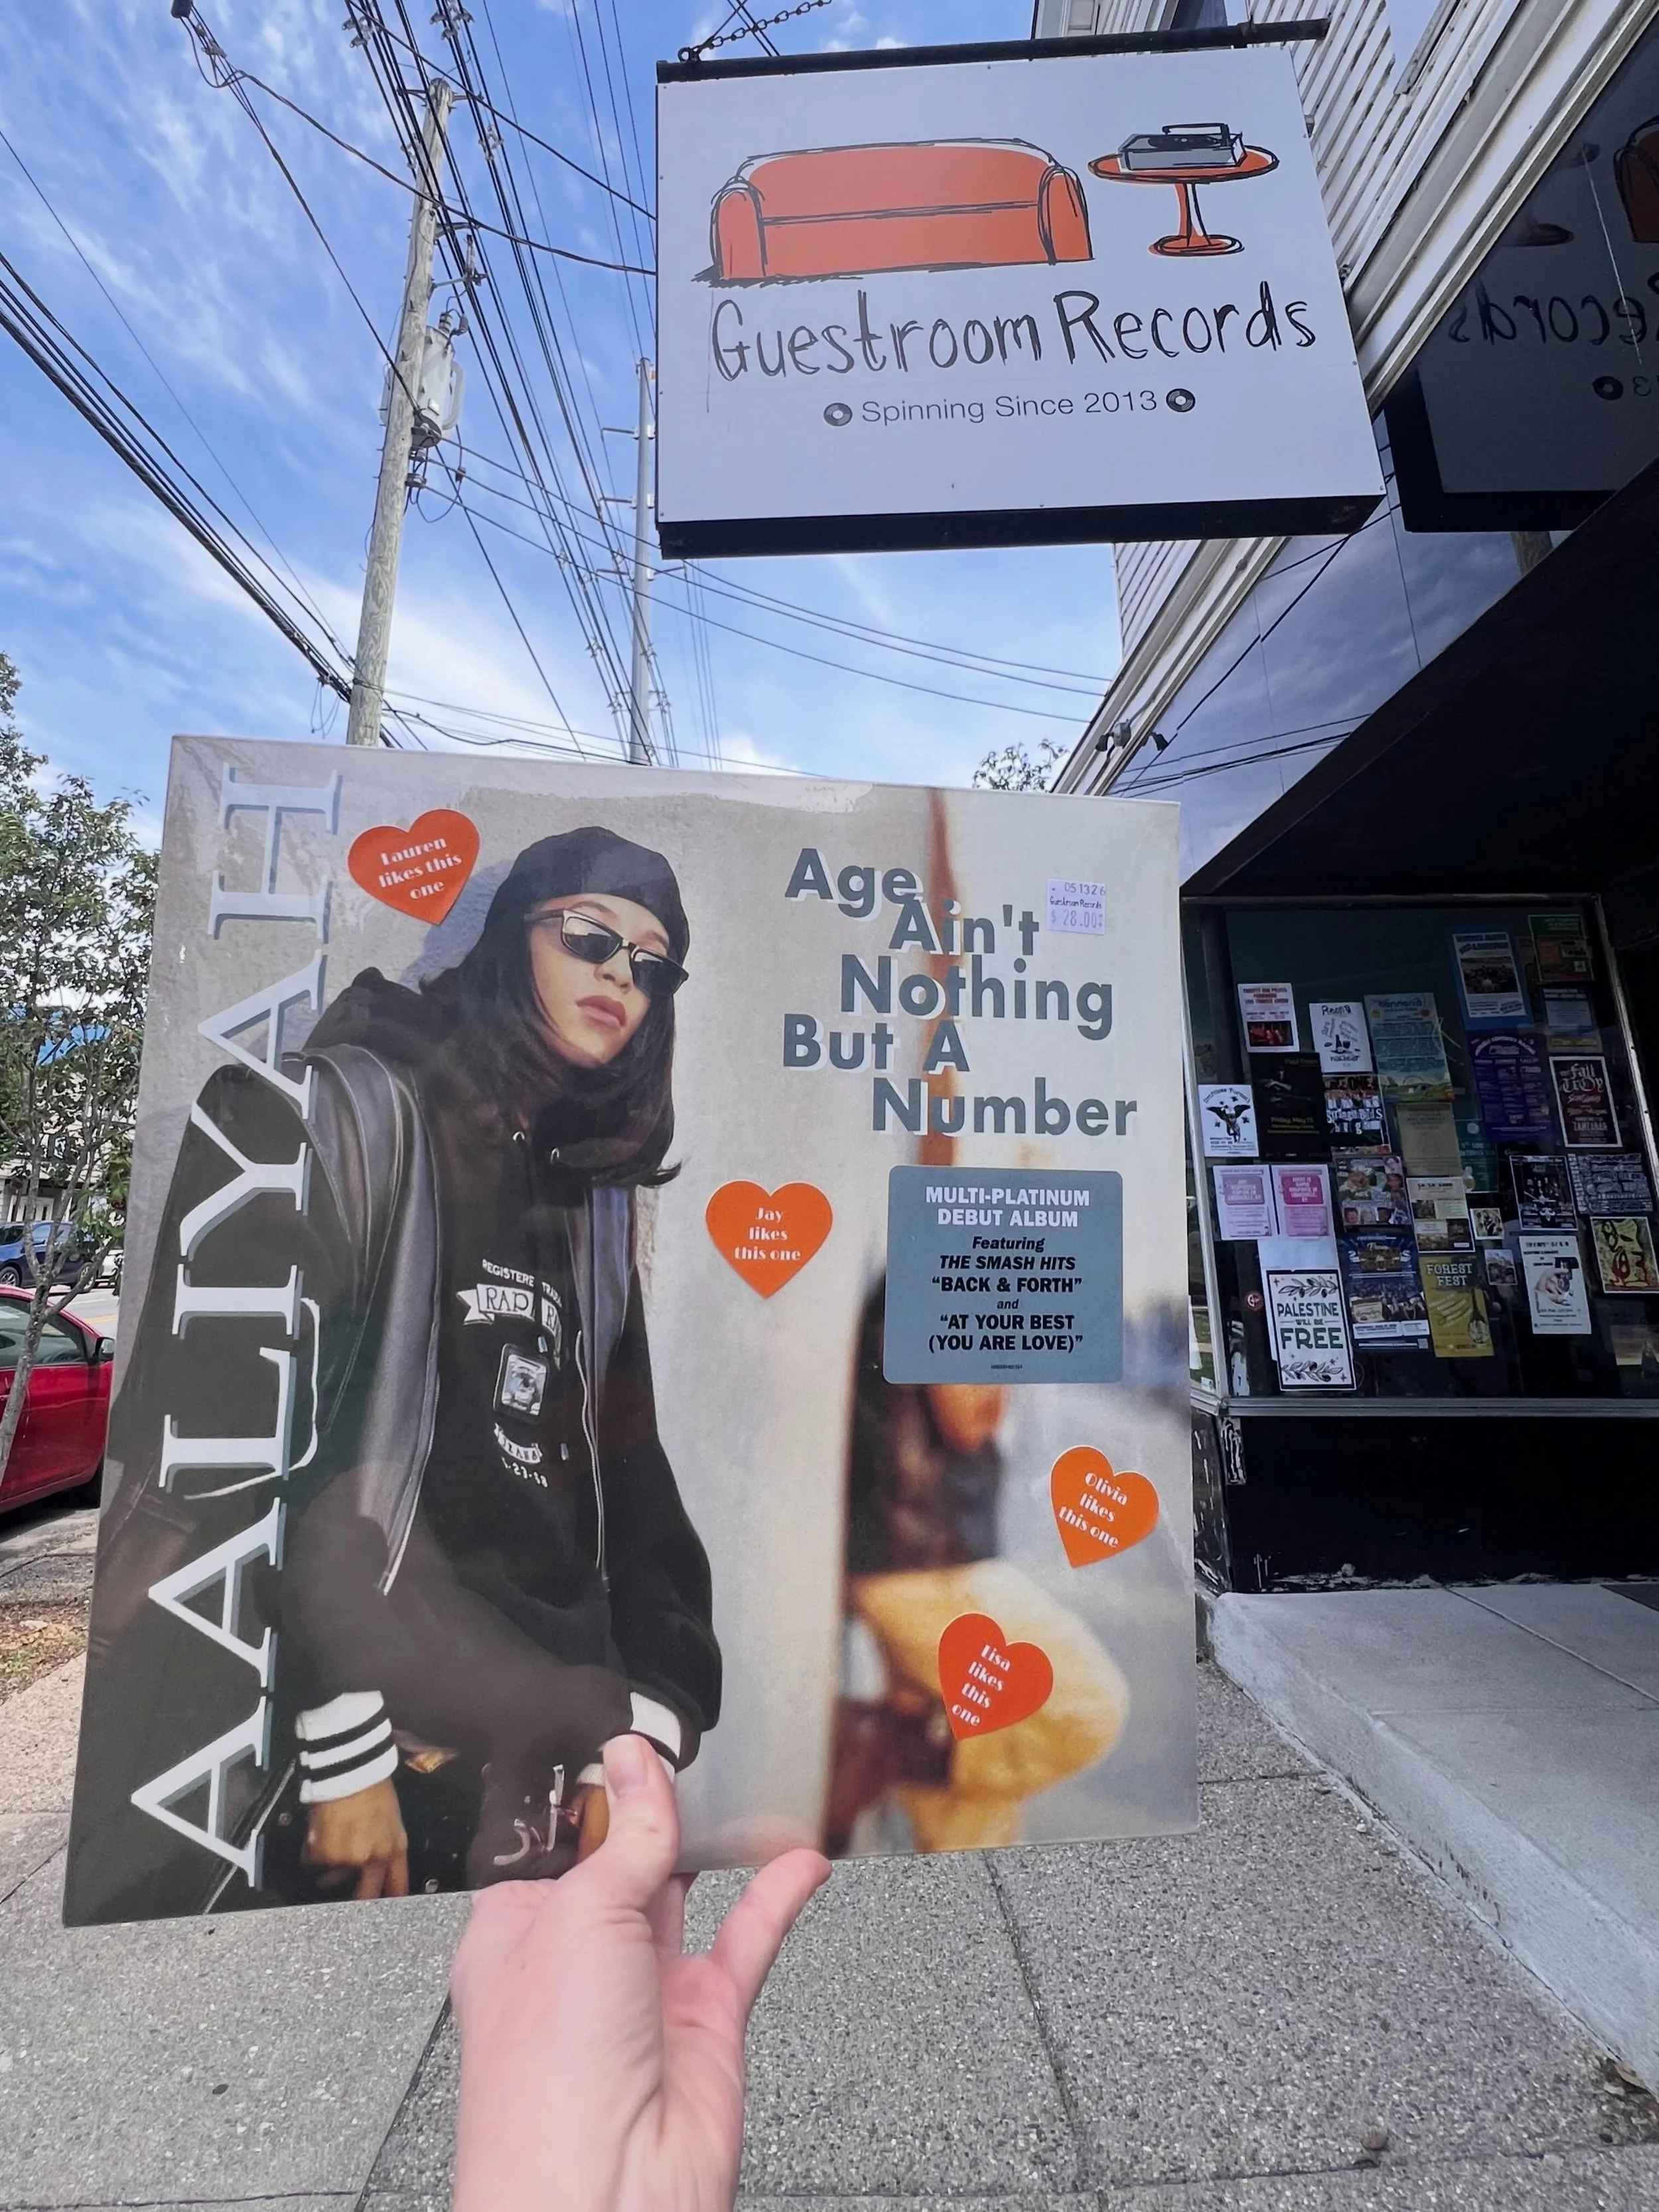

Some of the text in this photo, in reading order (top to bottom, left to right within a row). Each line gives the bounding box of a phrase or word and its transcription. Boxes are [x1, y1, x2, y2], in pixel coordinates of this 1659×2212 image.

[713, 281, 1316, 382] Guestroom Records
[862, 390, 1157, 426] Spinning Since 2013
[380, 838, 447, 866] Lauren
[378, 853, 462, 888] likes this
[409, 881, 445, 899] one
[784, 848, 920, 919] Age
[889, 899, 1040, 956] Ain't
[841, 954, 1113, 1041] Nothing
[783, 1013, 970, 1072] But A
[872, 1077, 1137, 1136] Number
[926, 1186, 1090, 1207] MULTI-PLATINUM
[755, 1207, 783, 1222] Jay
[938, 1208, 1078, 1227] DEBUT ALBUM
[749, 1226, 788, 1240] likes
[972, 1236, 1046, 1253] Featuring
[735, 1246, 801, 1260] this one
[940, 1255, 1076, 1270] THE SMASH HITS
[1426, 1263, 1473, 1275] FOREST
[996, 1277, 1011, 1292] &
[1437, 1275, 1468, 1287] FEST
[997, 1298, 1019, 1309] and
[1277, 1302, 1339, 1317] PALESTINE
[131, 762, 343, 1890] AALIYAH
[975, 1314, 1025, 1330] YOUR
[1030, 1315, 1075, 1330] BEST
[928, 1335, 974, 1354] (YOU
[979, 1335, 1017, 1351] ARE
[1280, 1327, 1344, 1350] FREE
[1084, 1472, 1128, 1506] Olivia
[1079, 1493, 1116, 1522] likes
[1058, 1505, 1119, 1548] this one
[981, 1643, 1011, 1672] Lisa
[968, 1660, 1004, 1692] likes
[961, 1682, 991, 1708] this
[952, 1704, 980, 1726] one
